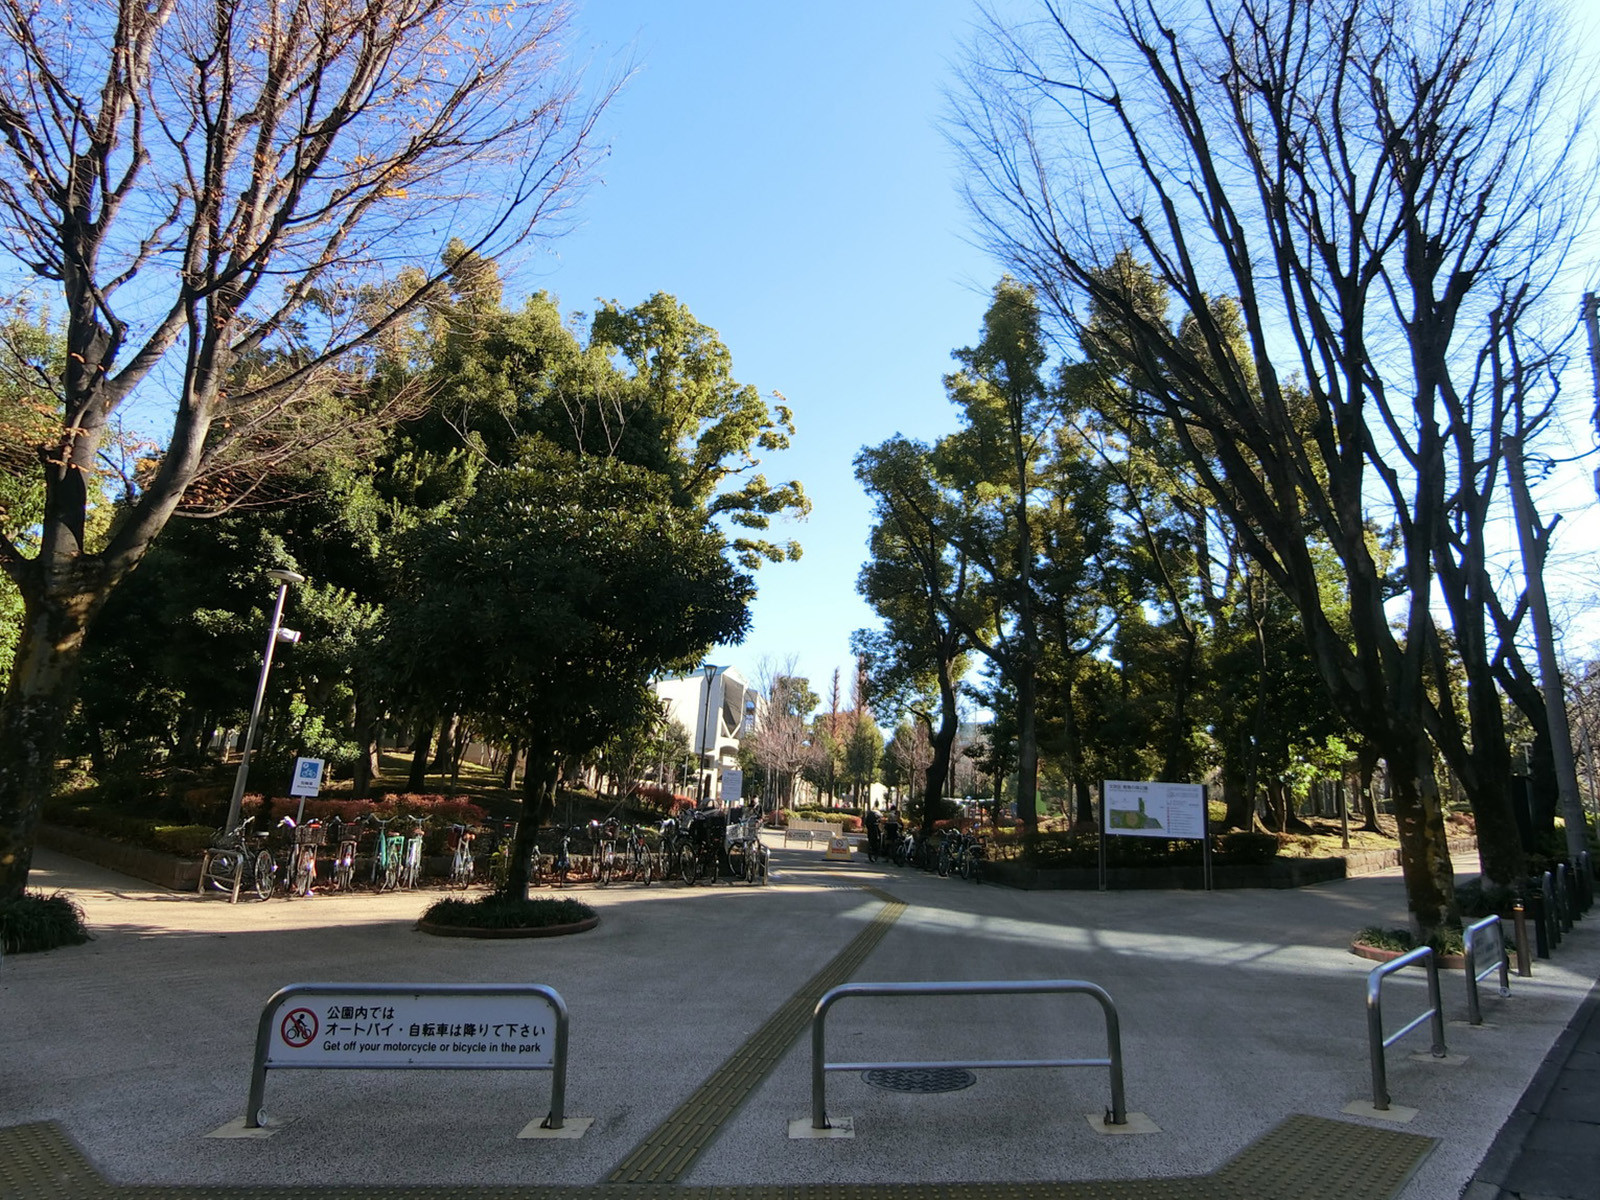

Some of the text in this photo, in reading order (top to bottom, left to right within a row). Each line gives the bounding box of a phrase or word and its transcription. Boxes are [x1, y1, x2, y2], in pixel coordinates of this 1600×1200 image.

[327, 1006, 395, 1020] 公園内では
[325, 1022, 546, 1038] オートバイ・自転車は降りて下さい
[323, 1041, 541, 1055] Get off your motorcycle or bicycle in the park
